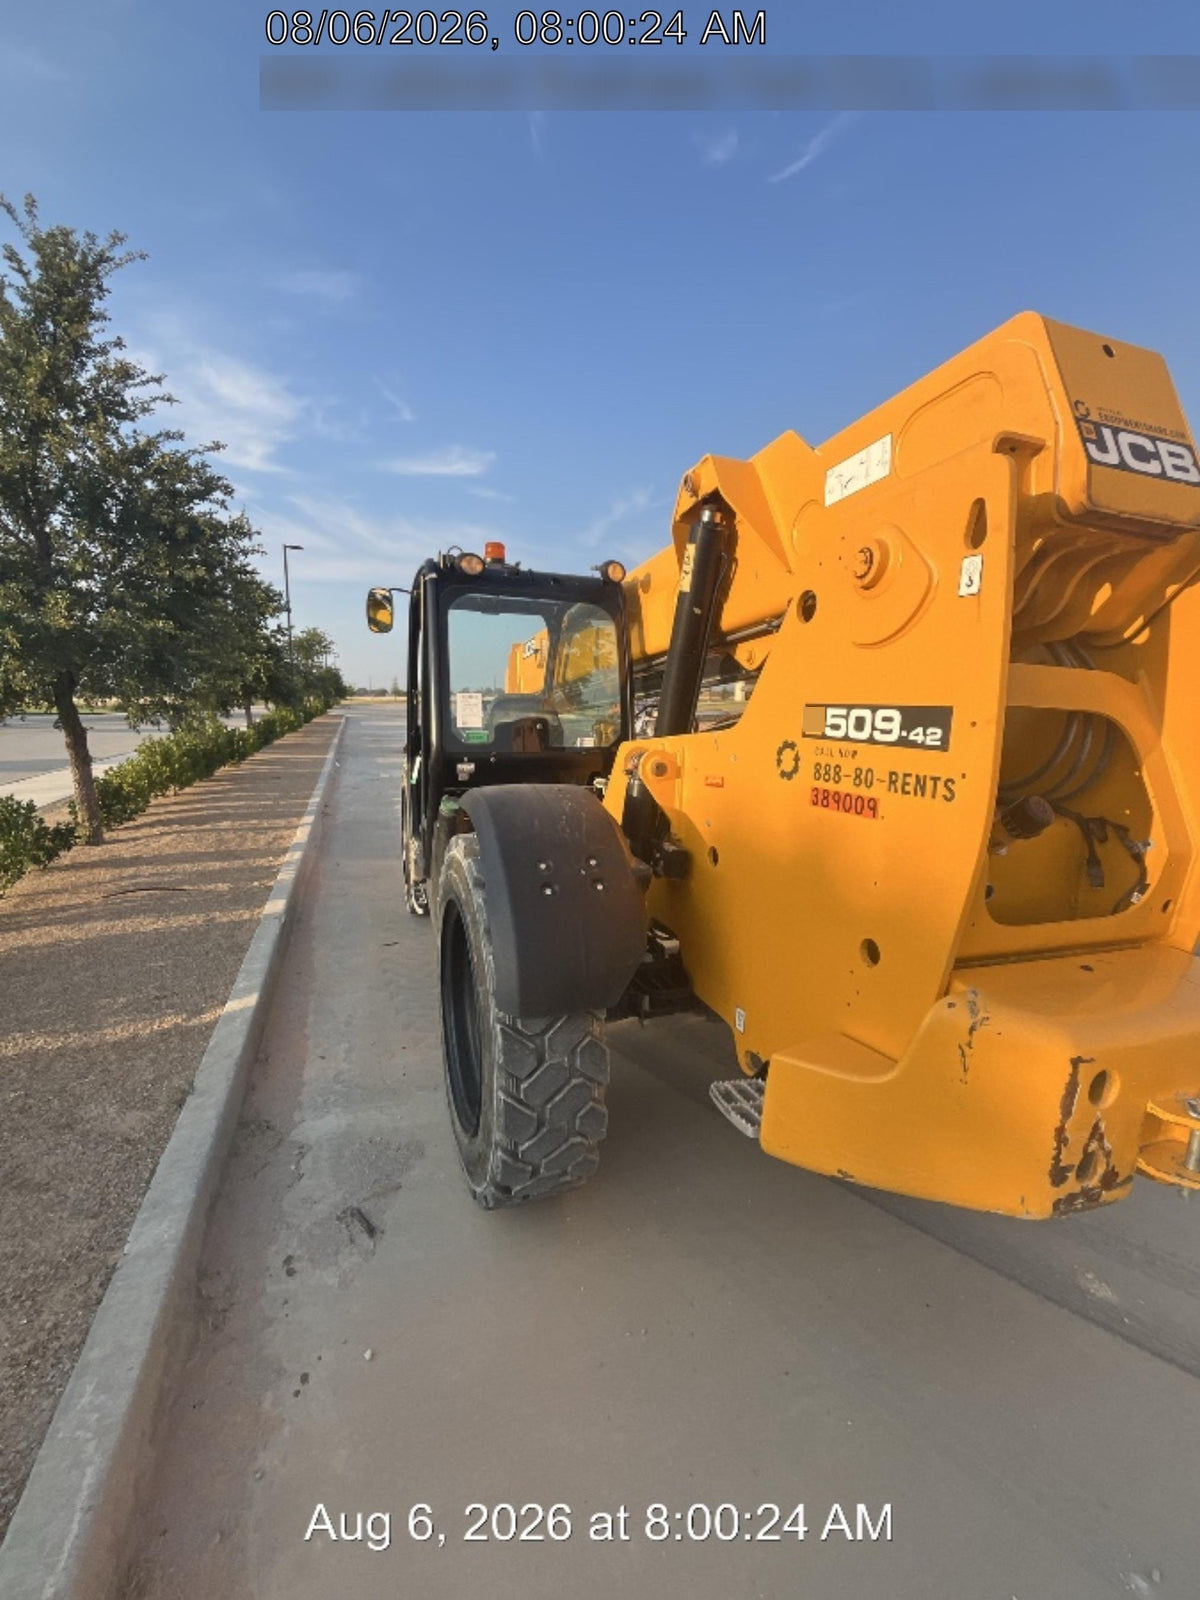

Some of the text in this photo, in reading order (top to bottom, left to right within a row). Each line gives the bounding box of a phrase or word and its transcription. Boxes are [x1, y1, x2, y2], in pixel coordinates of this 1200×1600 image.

[1085, 426, 1200, 482] JCB
[813, 762, 956, 802] 888-80-RENTS
[811, 787, 878, 818] 389009
